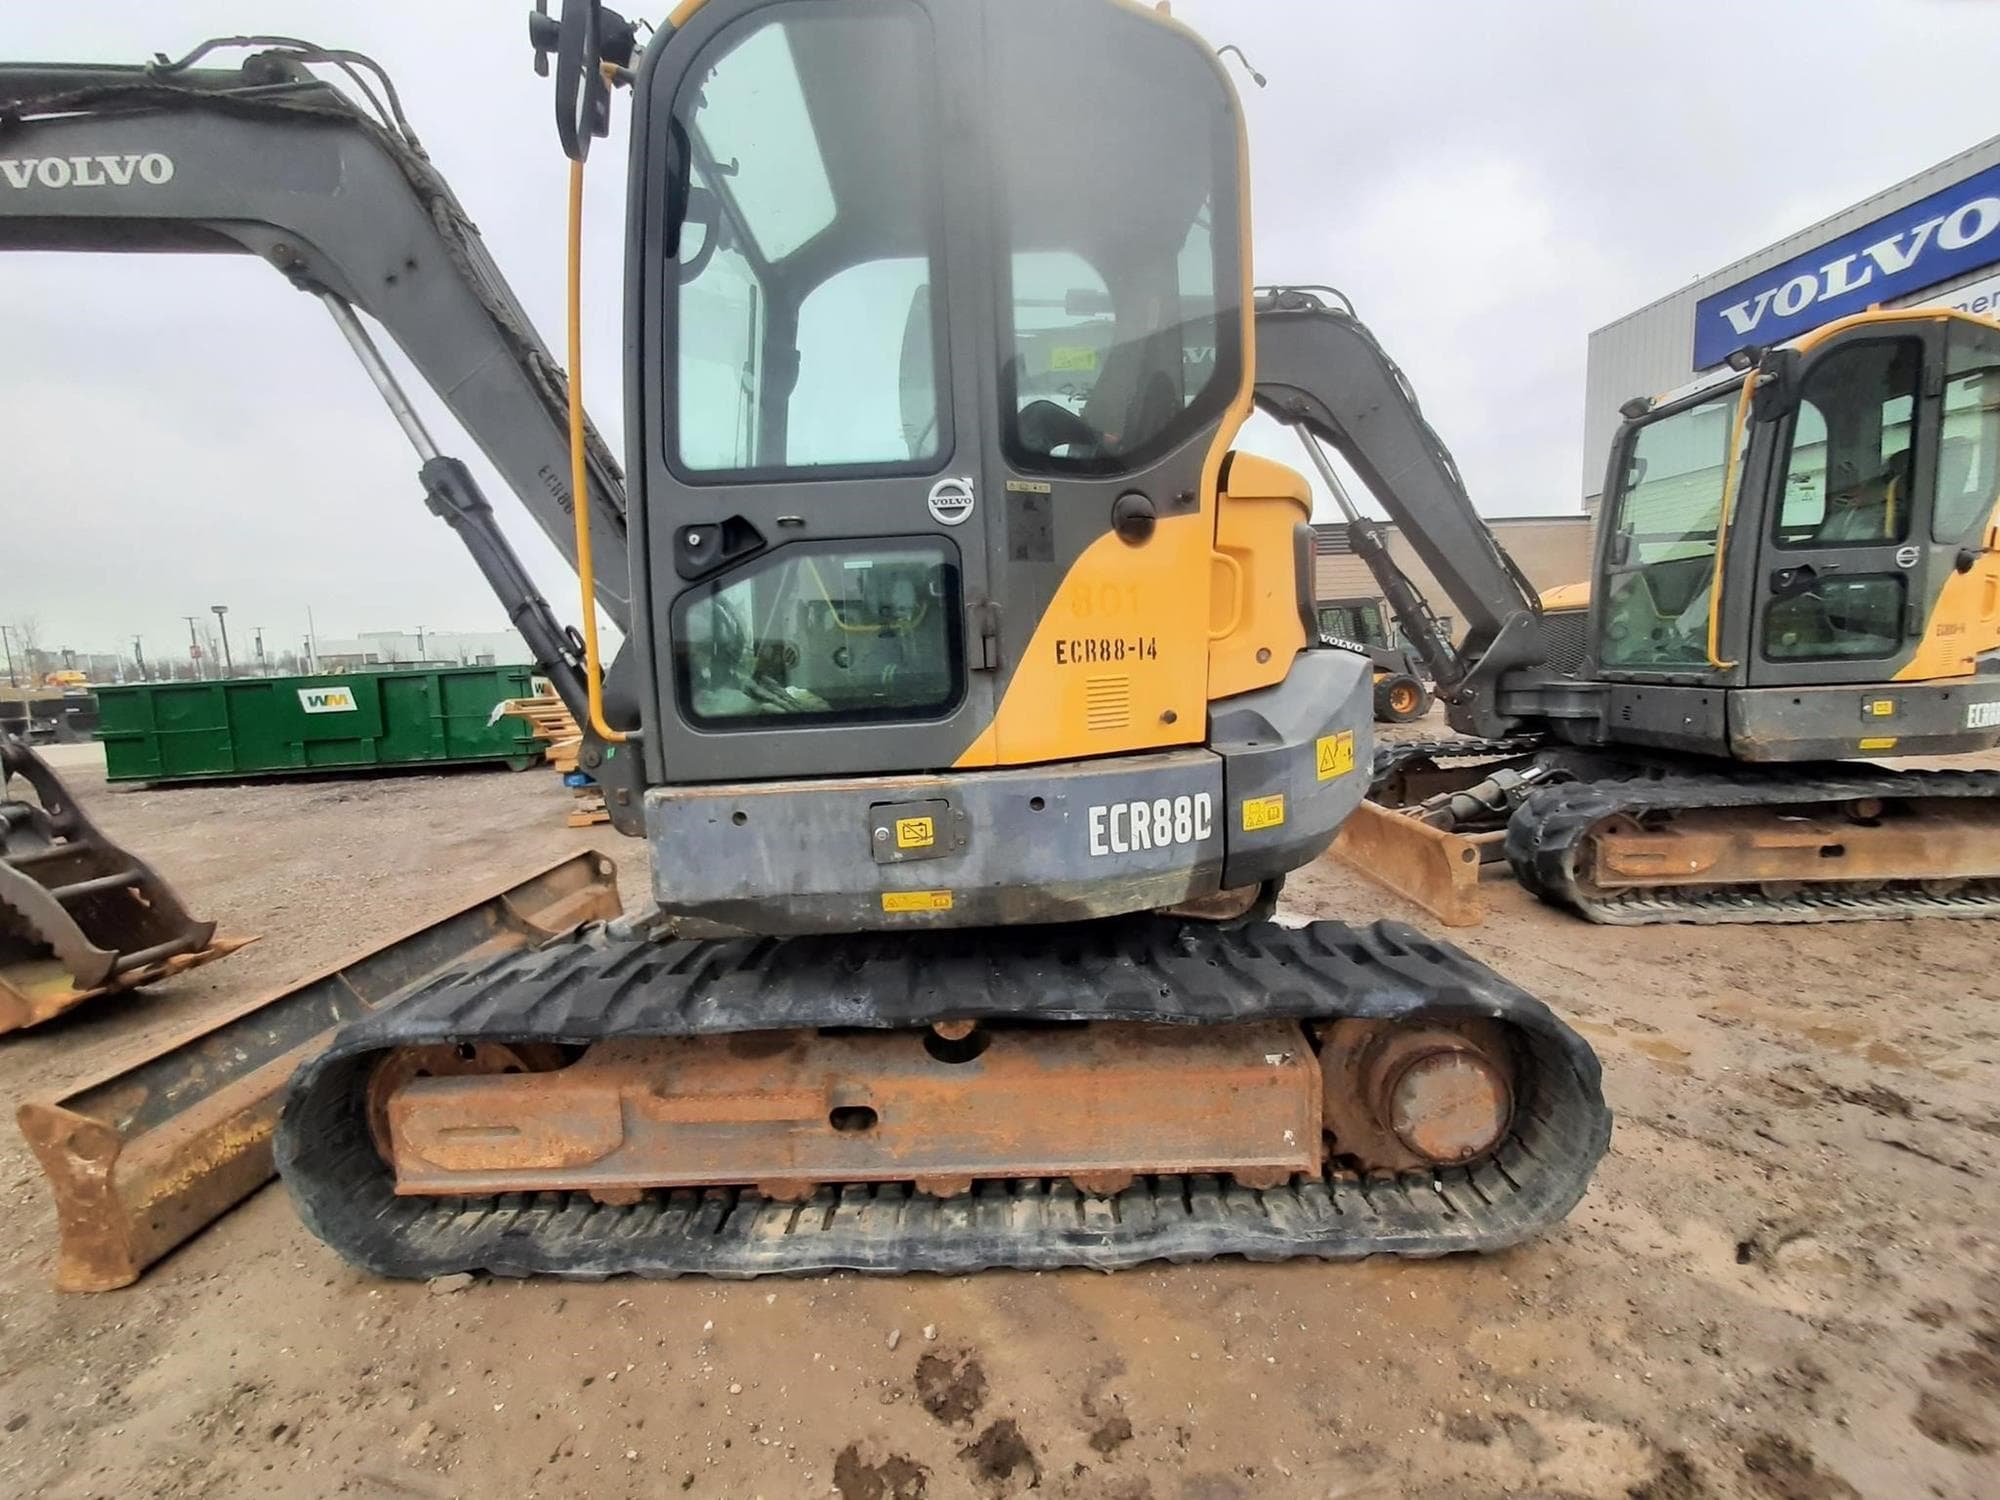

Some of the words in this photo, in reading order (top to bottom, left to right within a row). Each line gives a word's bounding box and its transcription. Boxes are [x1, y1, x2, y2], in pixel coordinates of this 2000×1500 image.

[0, 153, 174, 189] VOLVO
[1719, 197, 2000, 335] VOLVO
[931, 497, 973, 506] VOLVO
[1320, 633, 1364, 653] VOLVO
[307, 694, 349, 707] WM
[1088, 792, 1212, 856] ECR88D
